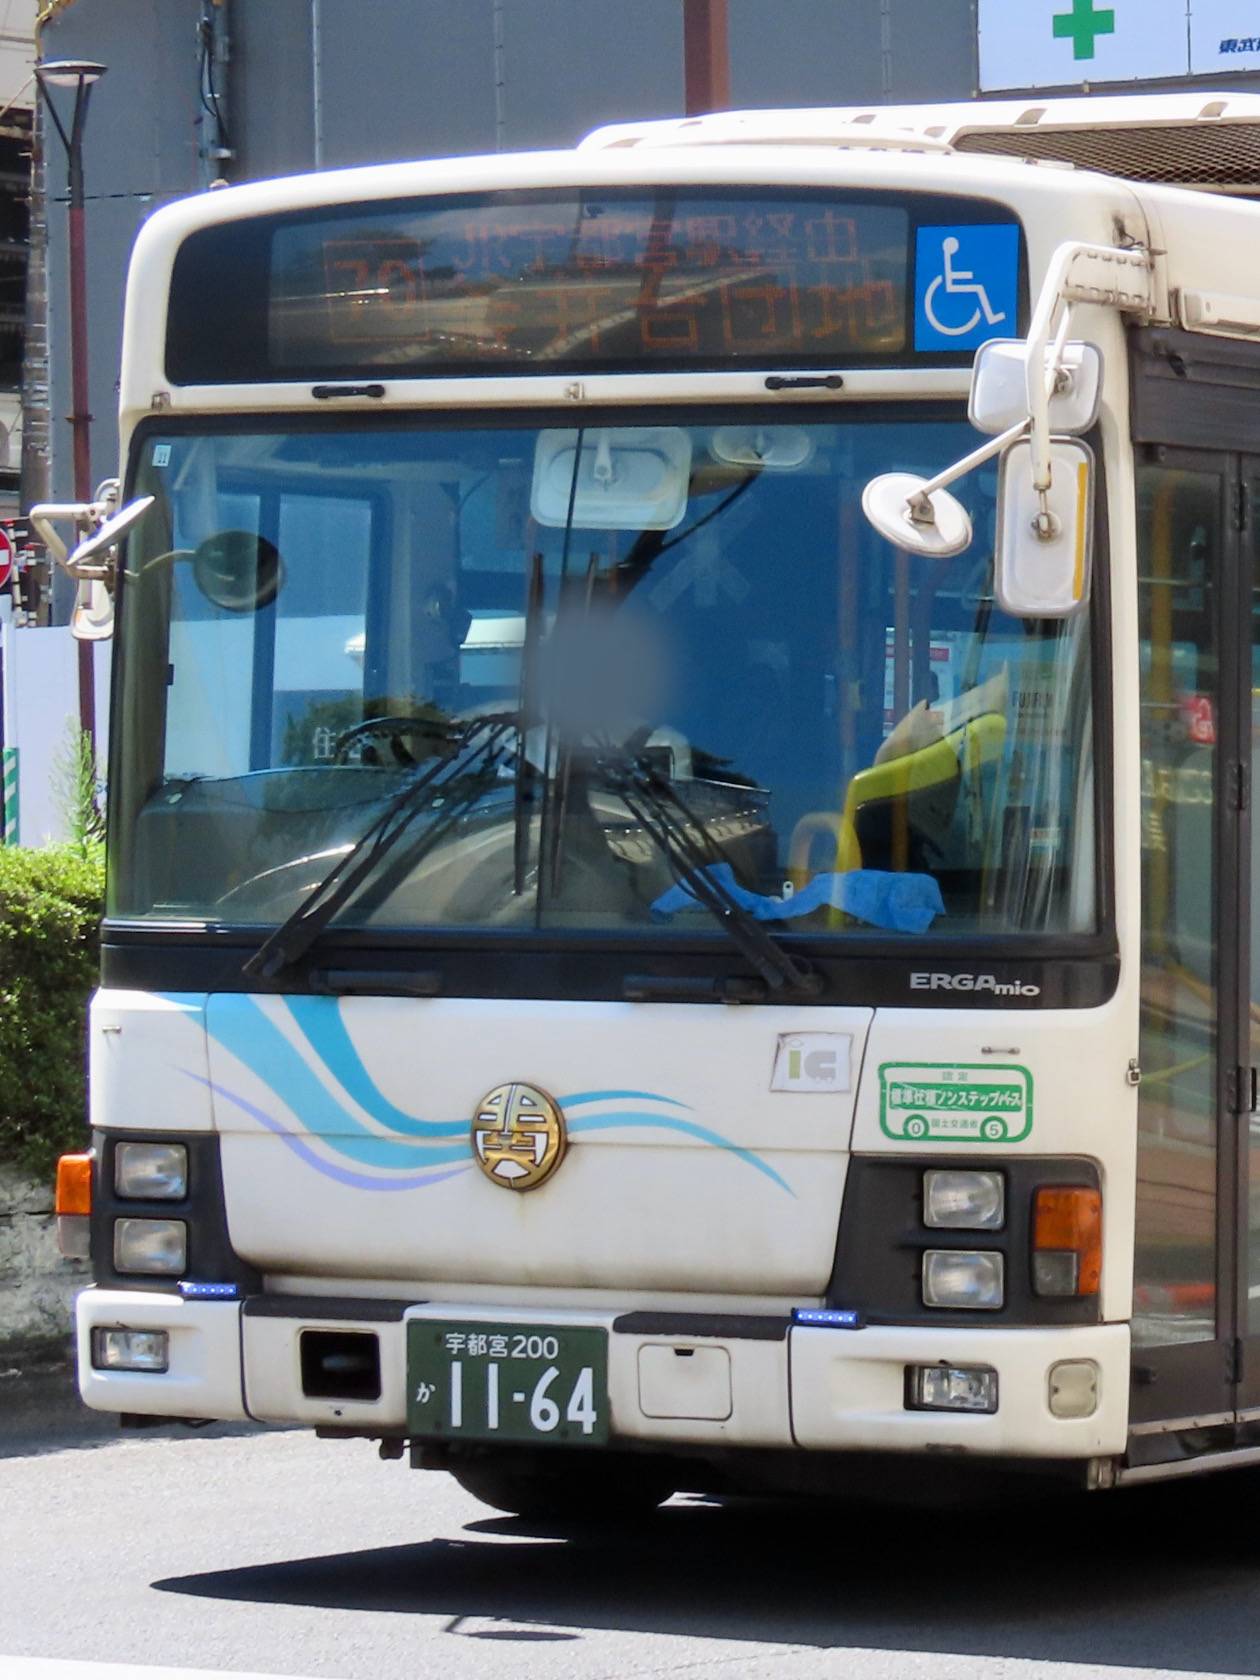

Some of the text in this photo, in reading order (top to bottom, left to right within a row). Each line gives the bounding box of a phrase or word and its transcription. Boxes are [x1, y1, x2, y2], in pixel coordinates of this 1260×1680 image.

[334, 259, 417, 322] 70
[415, 1360, 597, 1434] か 11-64
